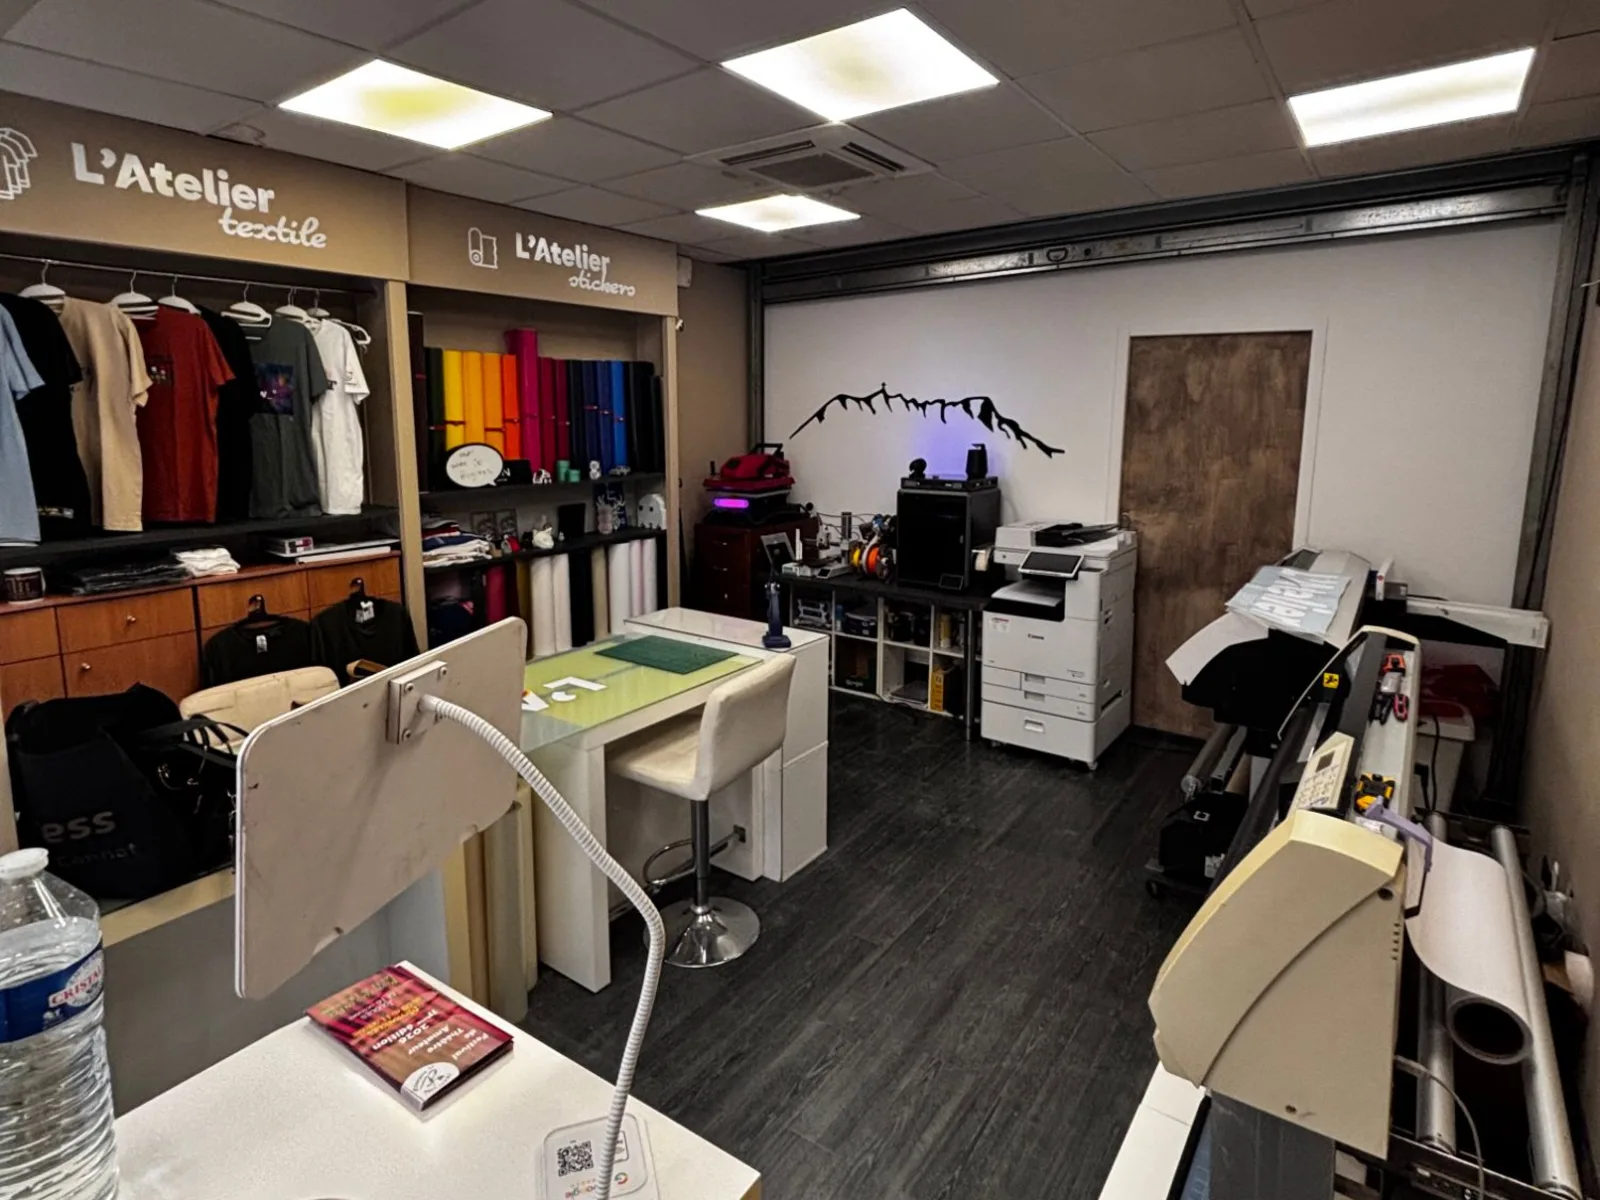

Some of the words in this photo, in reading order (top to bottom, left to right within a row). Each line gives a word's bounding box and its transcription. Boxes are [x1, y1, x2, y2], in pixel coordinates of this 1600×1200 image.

[71, 142, 274, 213] L'Atelier
[218, 207, 326, 248] textile
[516, 232, 610, 272] L'Atelier
[568, 268, 635, 296] stickers
[372, 1023, 415, 1051] édition
[398, 1023, 429, 1044] 2026
[408, 1025, 450, 1055] Amateur
[452, 1032, 489, 1060] Festival
[466, 1029, 477, 1039] de
